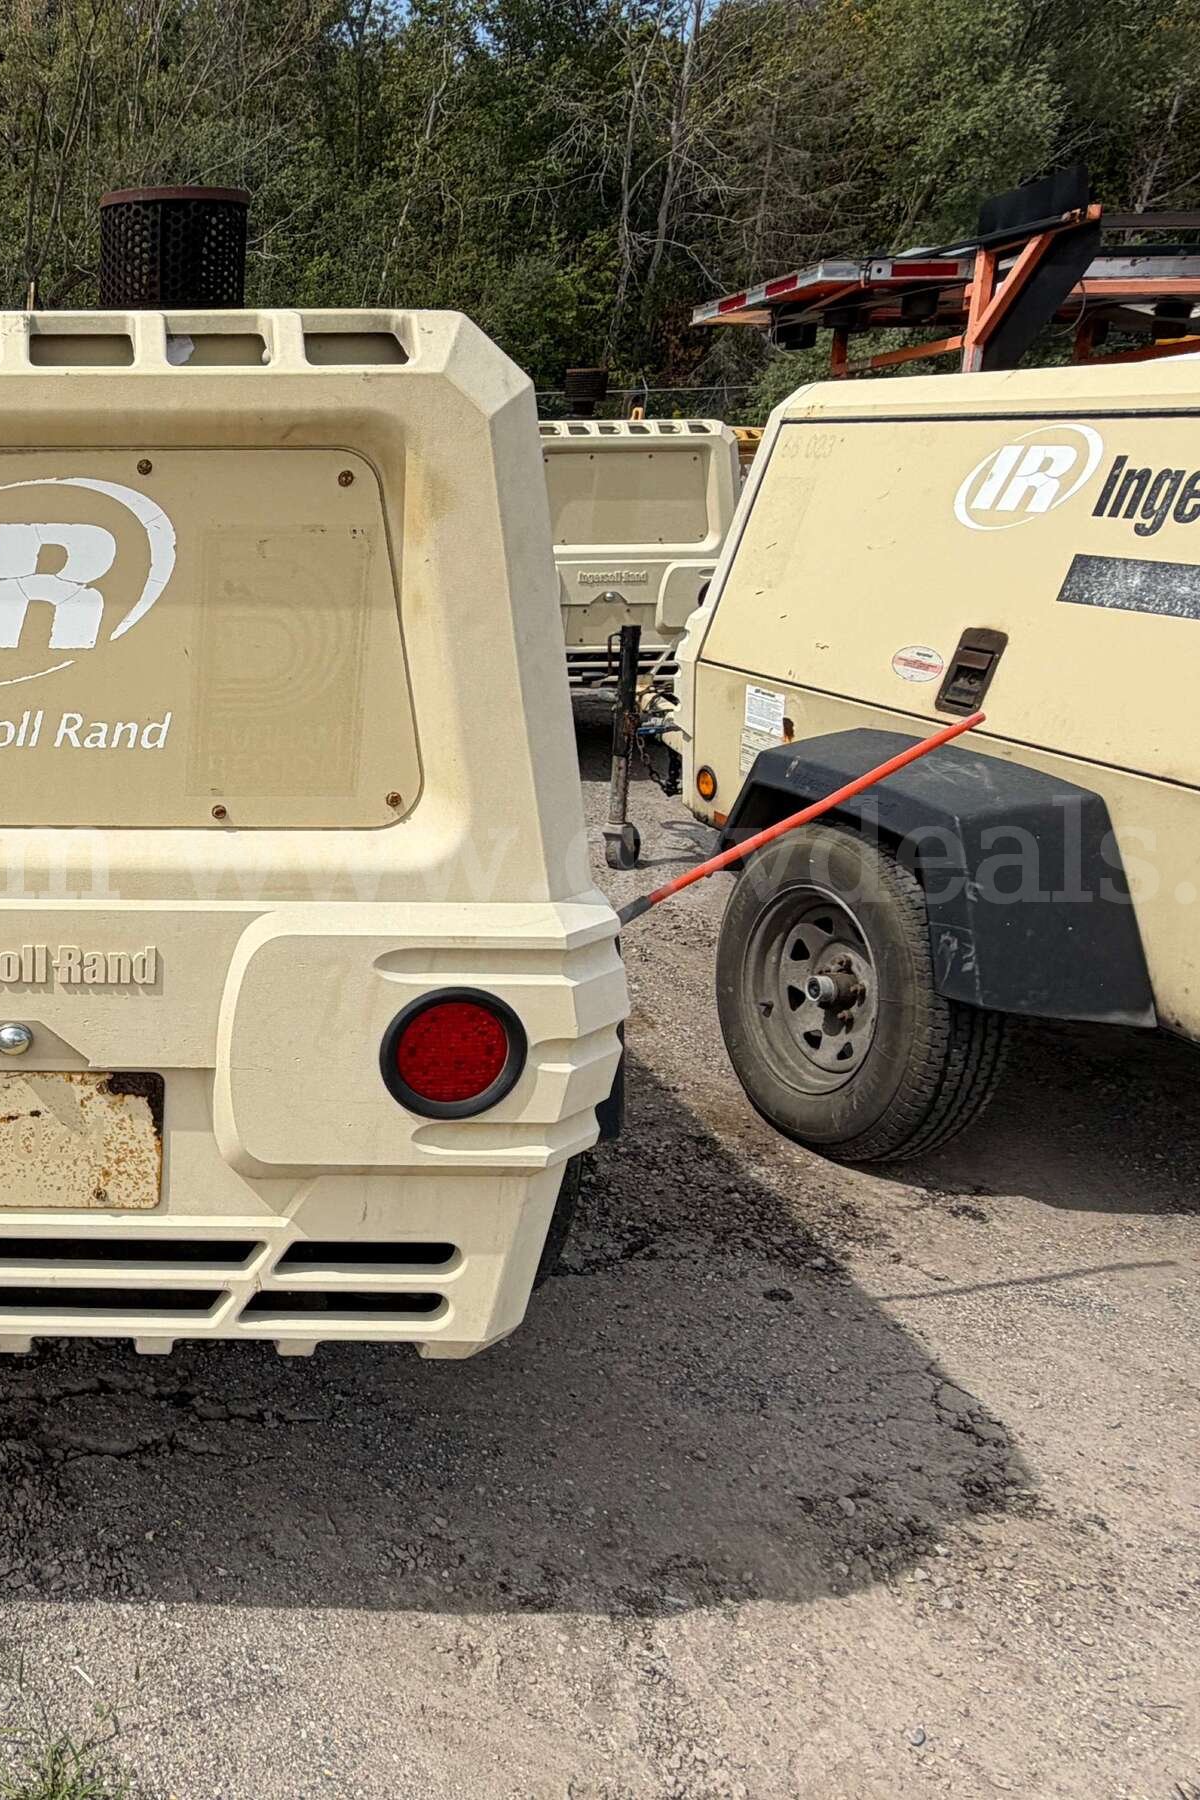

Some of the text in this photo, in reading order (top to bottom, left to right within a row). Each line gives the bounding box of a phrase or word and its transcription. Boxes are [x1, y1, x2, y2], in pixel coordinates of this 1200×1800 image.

[970, 445, 1078, 513] IR
[1091, 454, 1200, 537] Inge
[55, 710, 174, 751] Rand
